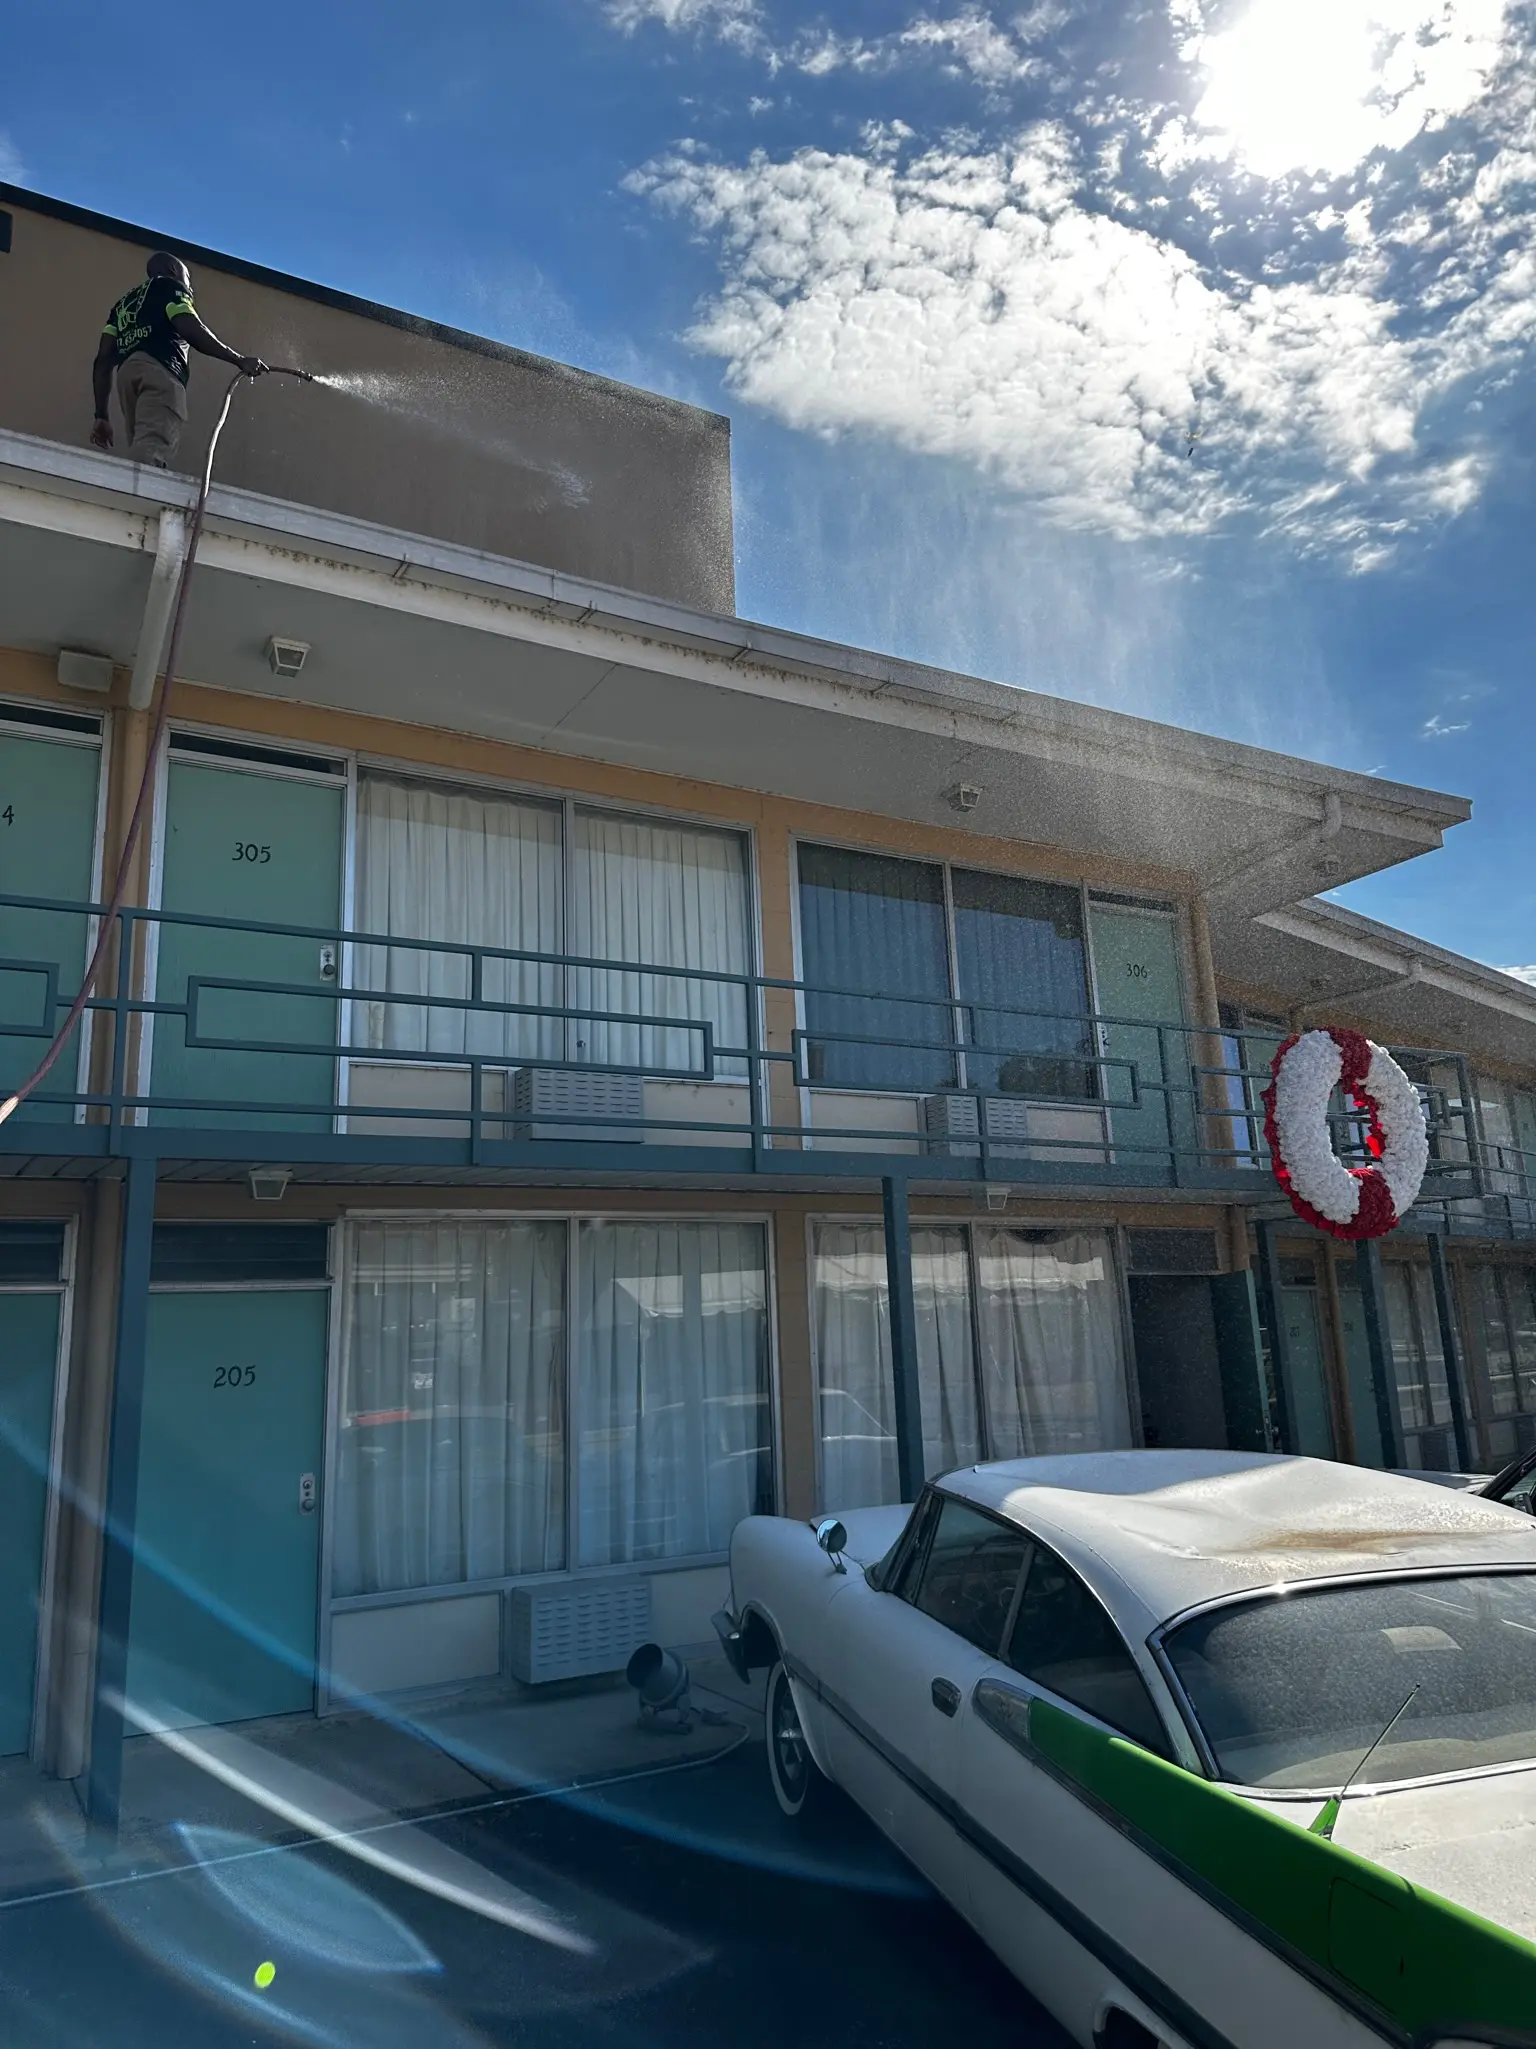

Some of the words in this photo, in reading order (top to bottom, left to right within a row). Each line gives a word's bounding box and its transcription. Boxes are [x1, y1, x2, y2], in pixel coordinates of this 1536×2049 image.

[231, 842, 272, 864] 305
[1126, 962, 1148, 979] 306
[213, 1364, 256, 1389] 205
